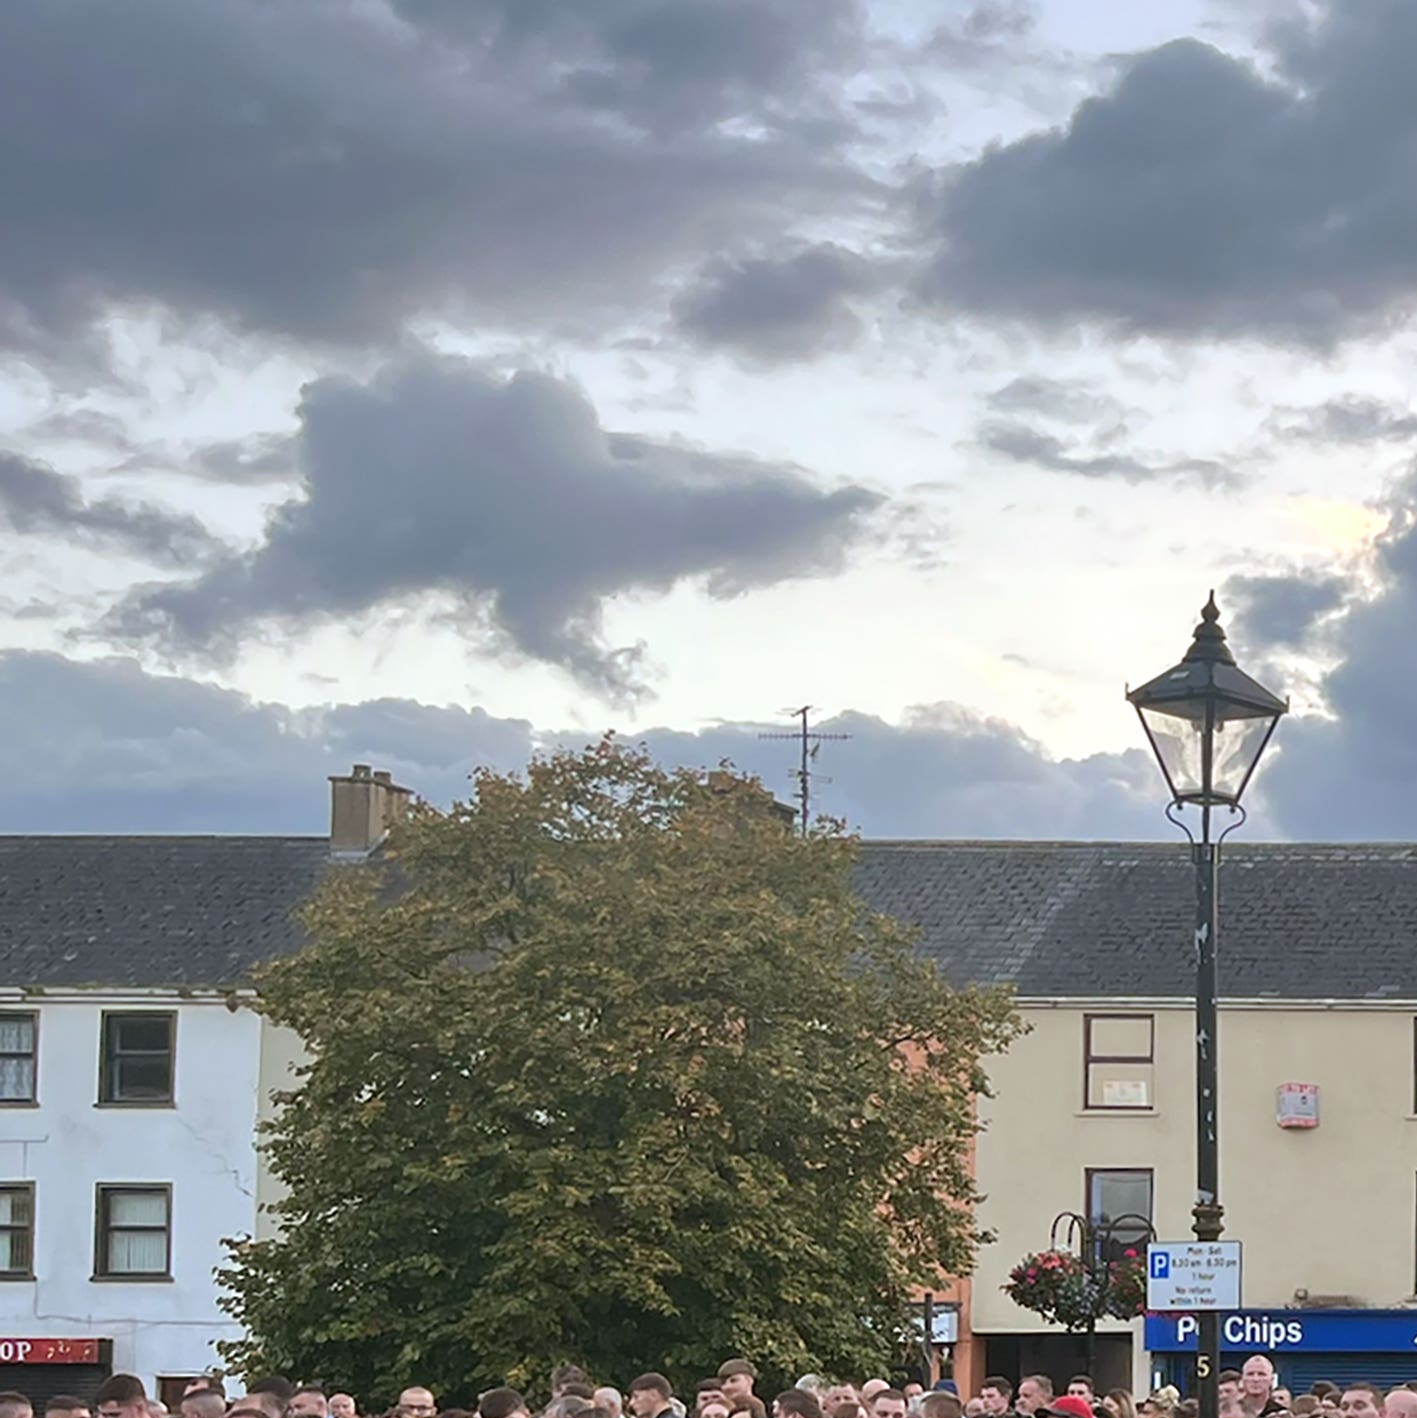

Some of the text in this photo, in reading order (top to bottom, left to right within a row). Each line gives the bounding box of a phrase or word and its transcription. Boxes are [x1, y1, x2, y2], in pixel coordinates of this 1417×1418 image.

[1154, 1255, 1167, 1277] P
[1198, 1272, 1215, 1280] hour
[1175, 1286, 1212, 1294] No return
[1200, 1297, 1216, 1305] hour
[1224, 1316, 1303, 1350] Chips
[1197, 1355, 1210, 1378] 5
